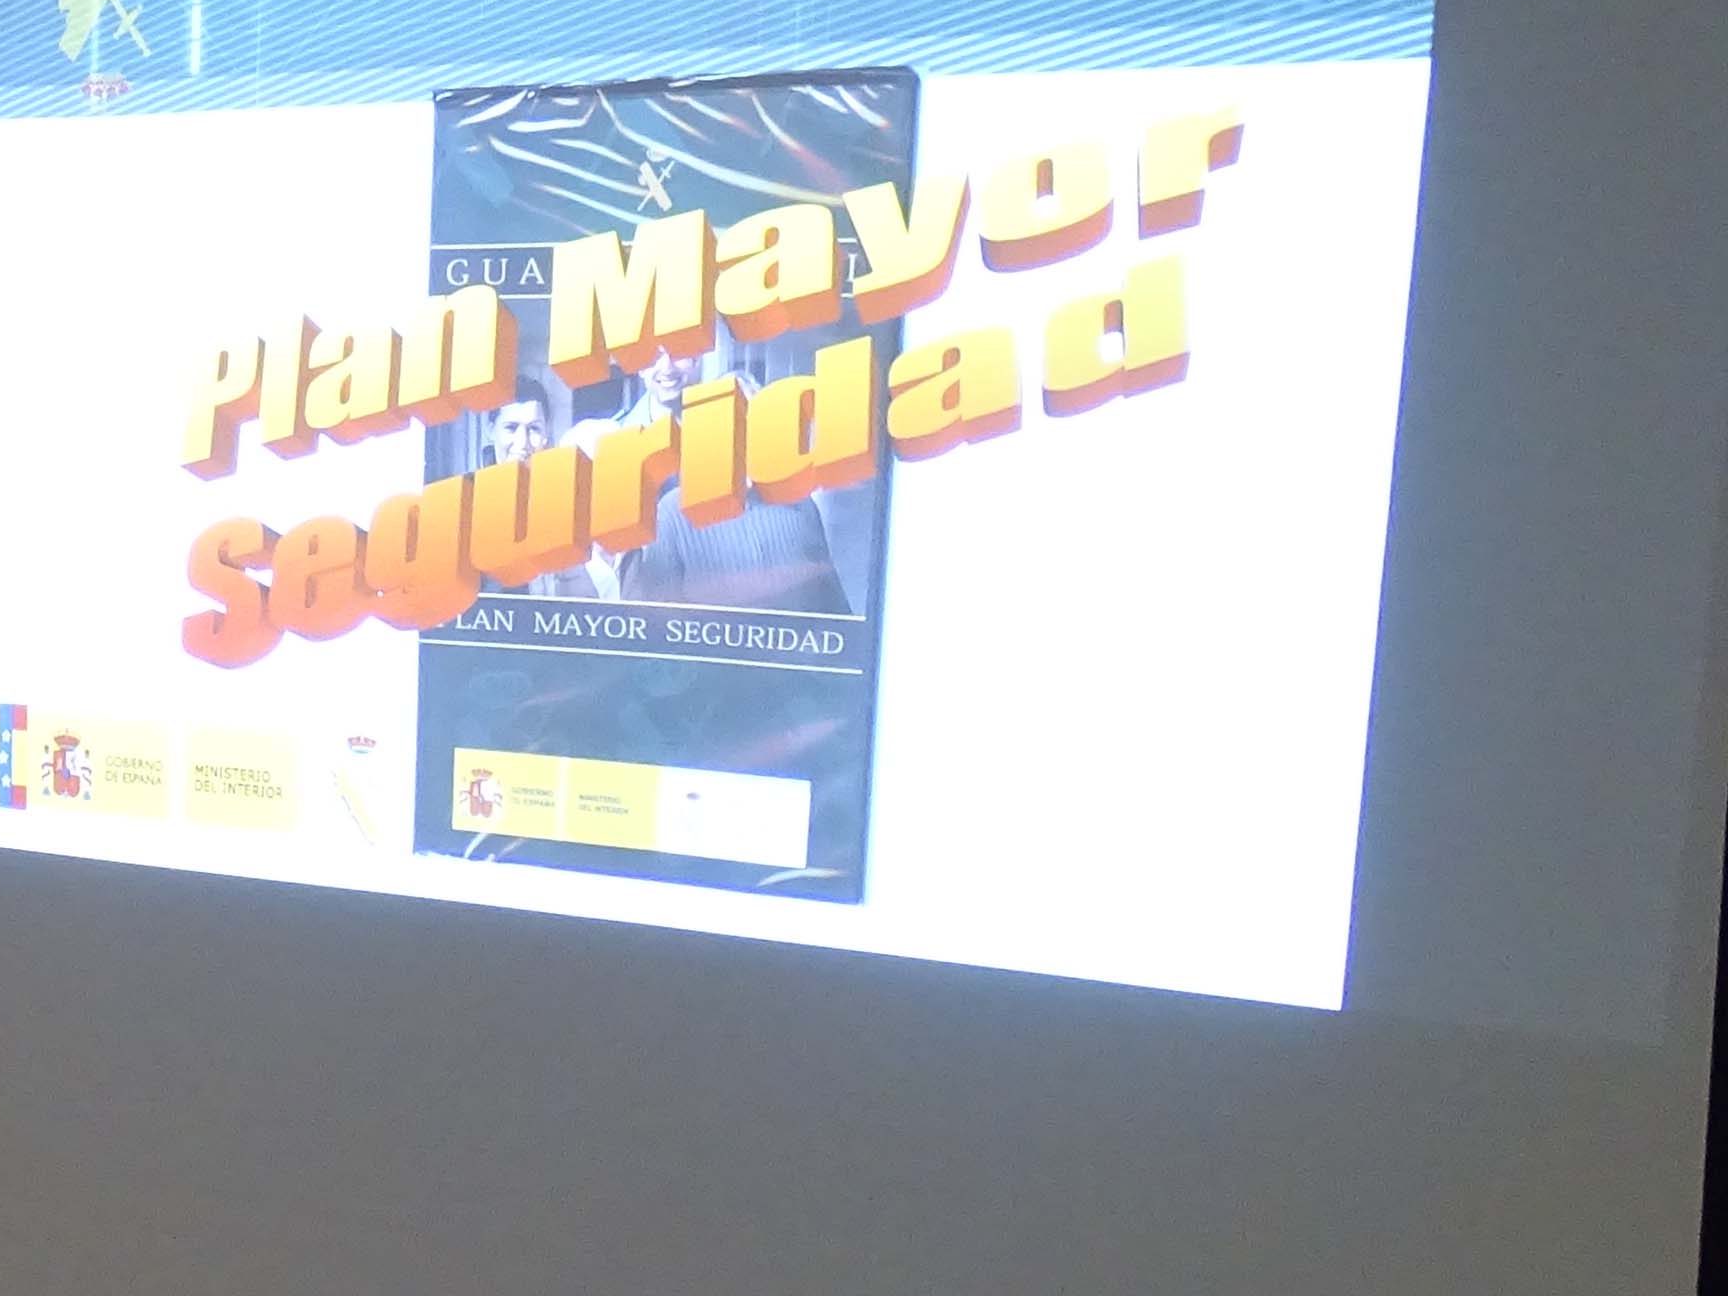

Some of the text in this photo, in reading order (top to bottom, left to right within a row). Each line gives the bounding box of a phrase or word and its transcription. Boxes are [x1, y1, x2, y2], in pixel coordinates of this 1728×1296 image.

[180, 104, 1246, 482] Plan Mayor
[182, 253, 1191, 670] Seguridad
[437, 607, 845, 655] LAN MAYOR SEGURIDAD
[194, 764, 272, 784] MINISTERIO
[194, 778, 284, 800] DEL INTERIOR
